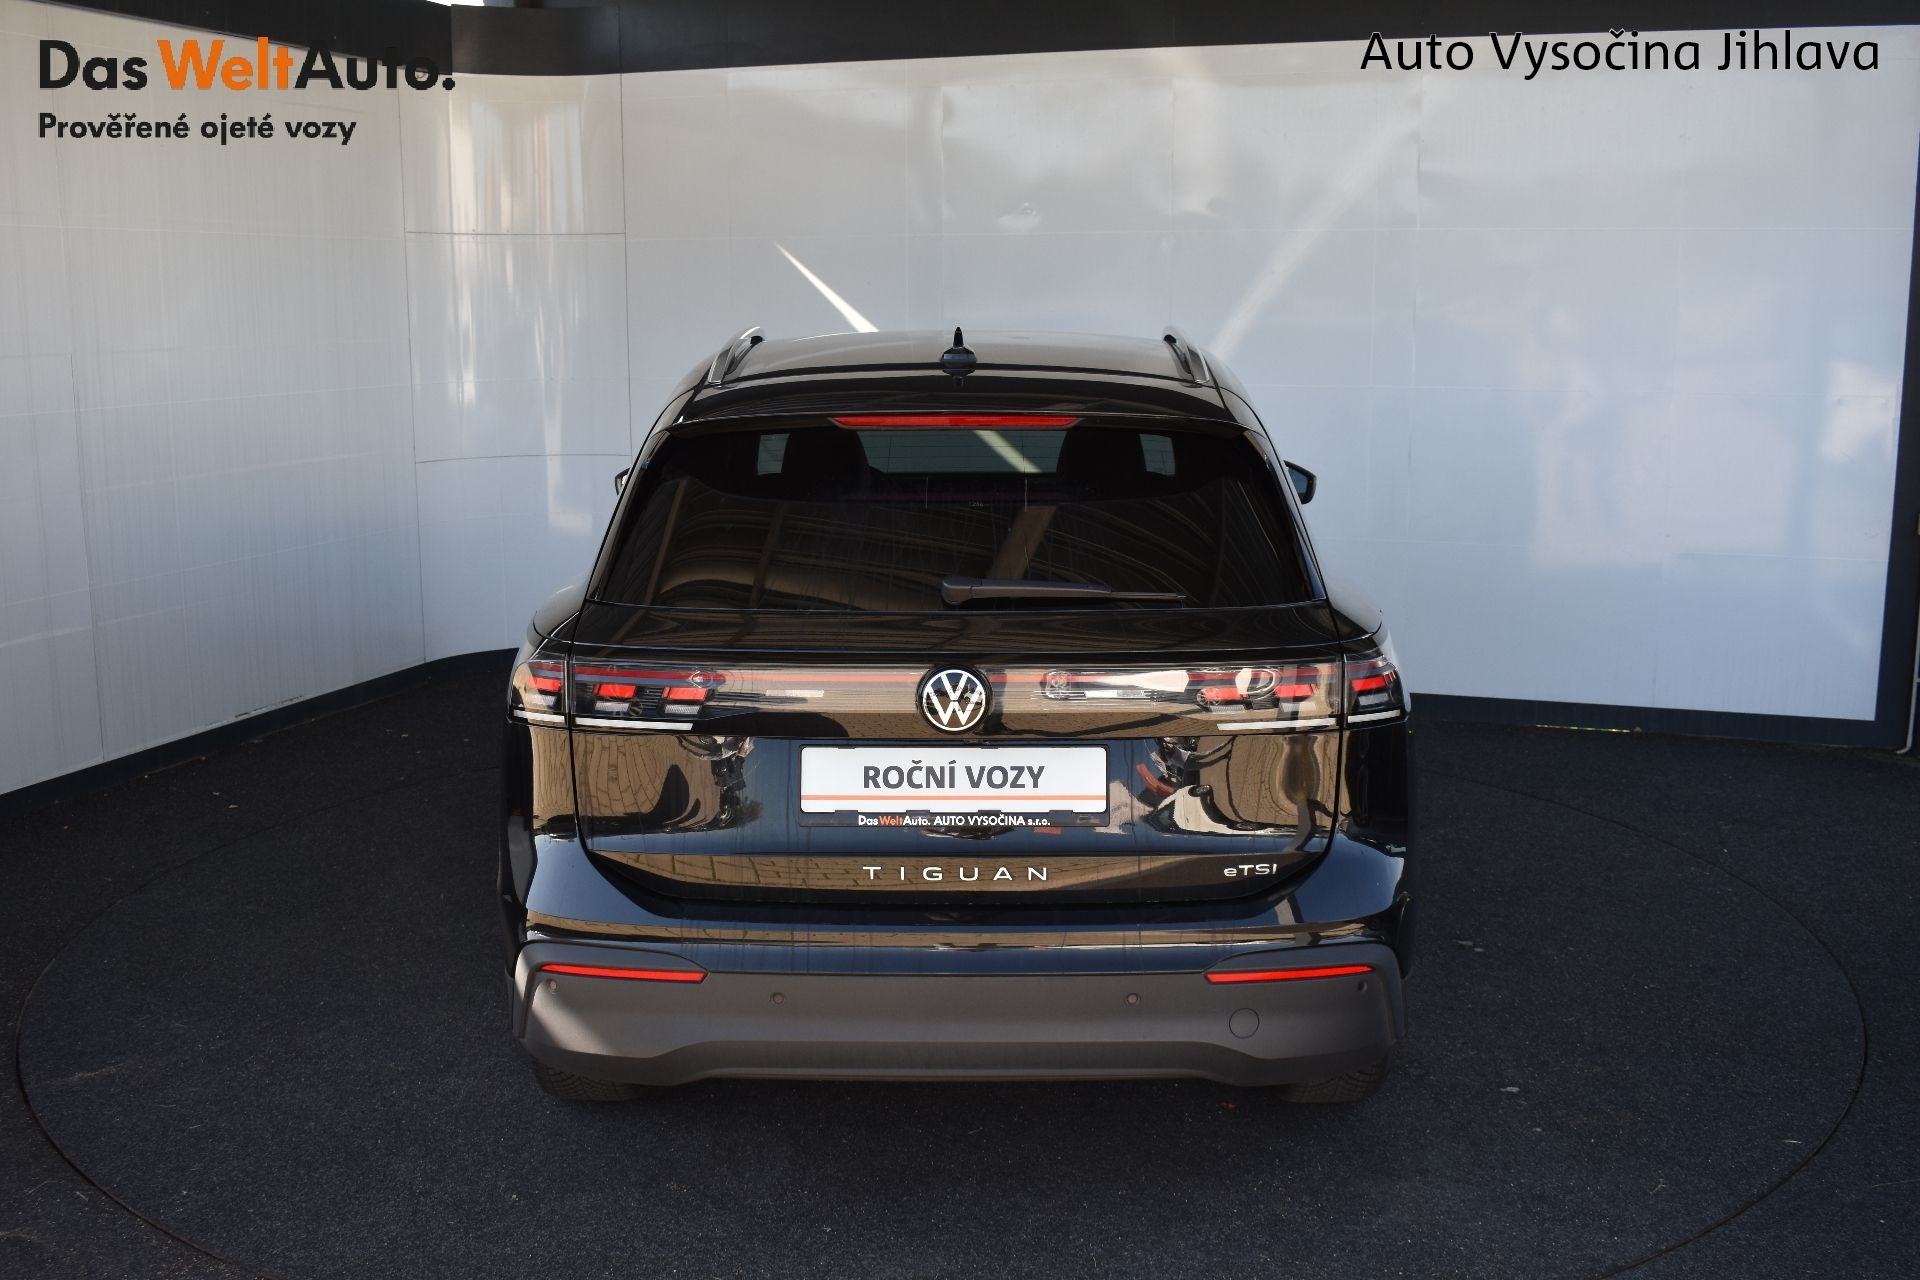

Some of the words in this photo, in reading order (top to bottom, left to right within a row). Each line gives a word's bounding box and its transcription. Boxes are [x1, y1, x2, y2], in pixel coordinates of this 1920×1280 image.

[863, 759, 957, 789] ROČNÍ
[965, 765, 1045, 789] VOZY
[933, 815, 965, 826] AUTO
[967, 813, 1026, 826] VYSOČINA
[1027, 818, 1051, 826] s.r.o.
[862, 866, 1047, 881] TIGUAN
[1223, 863, 1278, 878] eTSI
